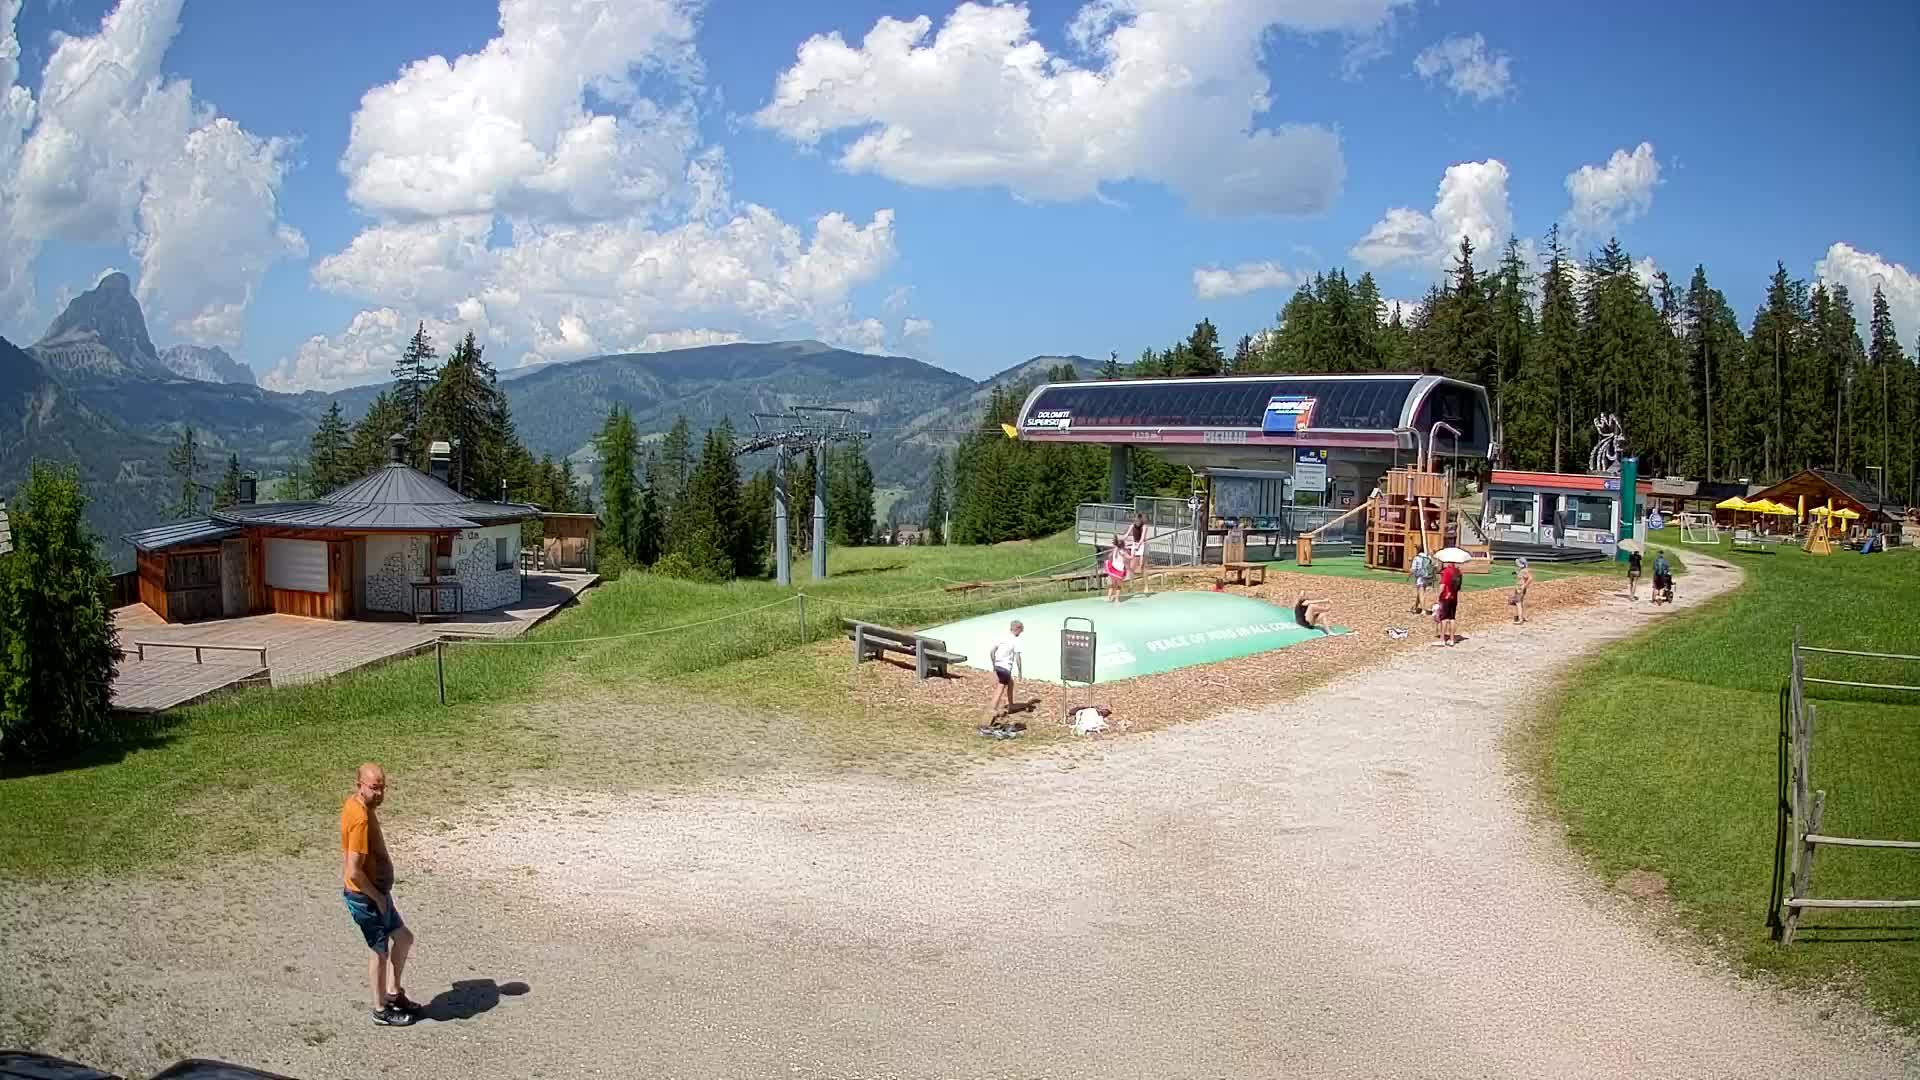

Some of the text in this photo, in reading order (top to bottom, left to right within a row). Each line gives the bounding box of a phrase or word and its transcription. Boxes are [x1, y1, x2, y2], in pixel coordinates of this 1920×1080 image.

[1146, 635, 1191, 652] PEACE
[1189, 631, 1205, 645] OF
[1250, 624, 1271, 635] ALL
